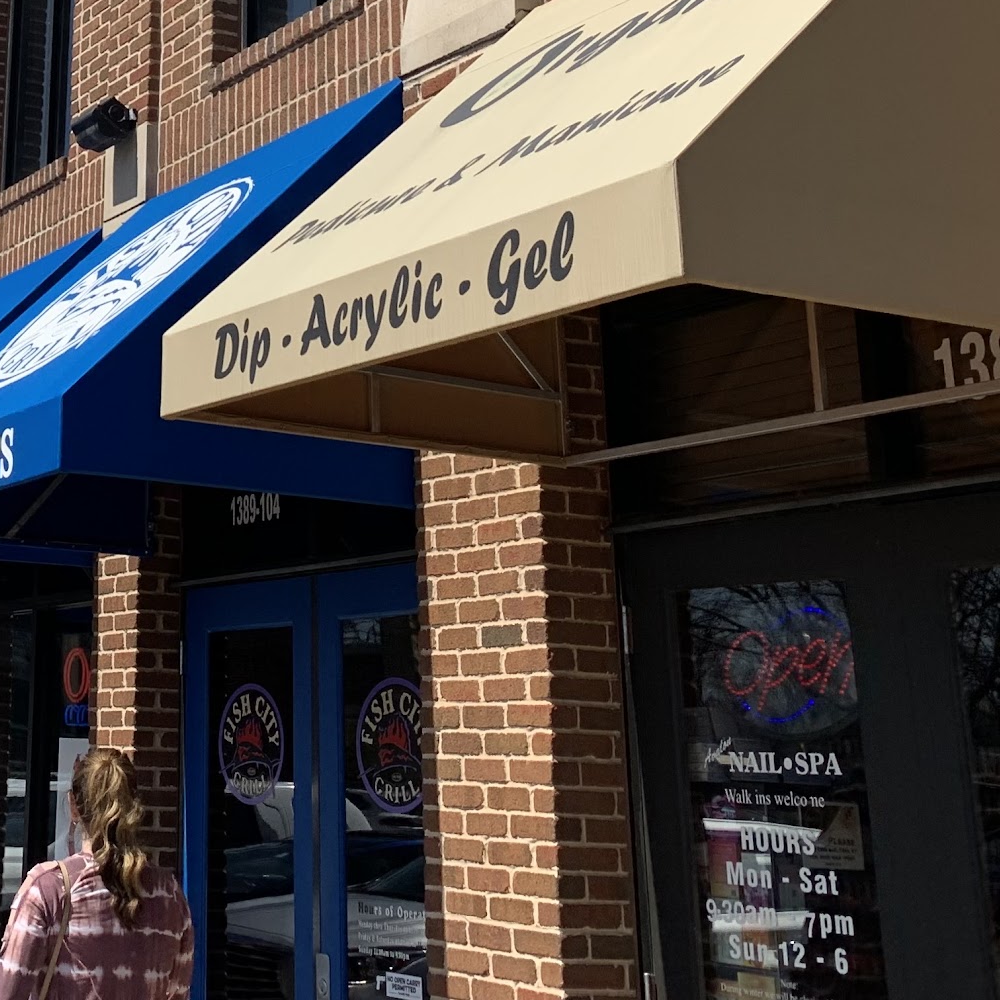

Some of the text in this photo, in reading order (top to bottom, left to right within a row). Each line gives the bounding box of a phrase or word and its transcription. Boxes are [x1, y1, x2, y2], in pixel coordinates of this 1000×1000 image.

[271, 54, 745, 253] Pedicure & Manicure
[214, 210, 575, 383] Dip Acrylic Gel
[230, 492, 281, 526] 1389-104
[723, 629, 853, 712] Open
[223, 693, 280, 746] FISH CITY
[361, 688, 395, 745] FISH
[374, 776, 421, 804] GRILL
[724, 788, 752, 805] Walk
[754, 789, 772, 806] ins
[740, 826, 816, 856] HOURS
[725, 861, 772, 889] Mon
[798, 866, 839, 896] Sat
[357, 901, 382, 916] Hours
[385, 905, 393, 918] of
[804, 911, 855, 939] 7pm
[728, 934, 769, 963] Sun
[778, 941, 807, 969] 12
[834, 947, 849, 975] 6
